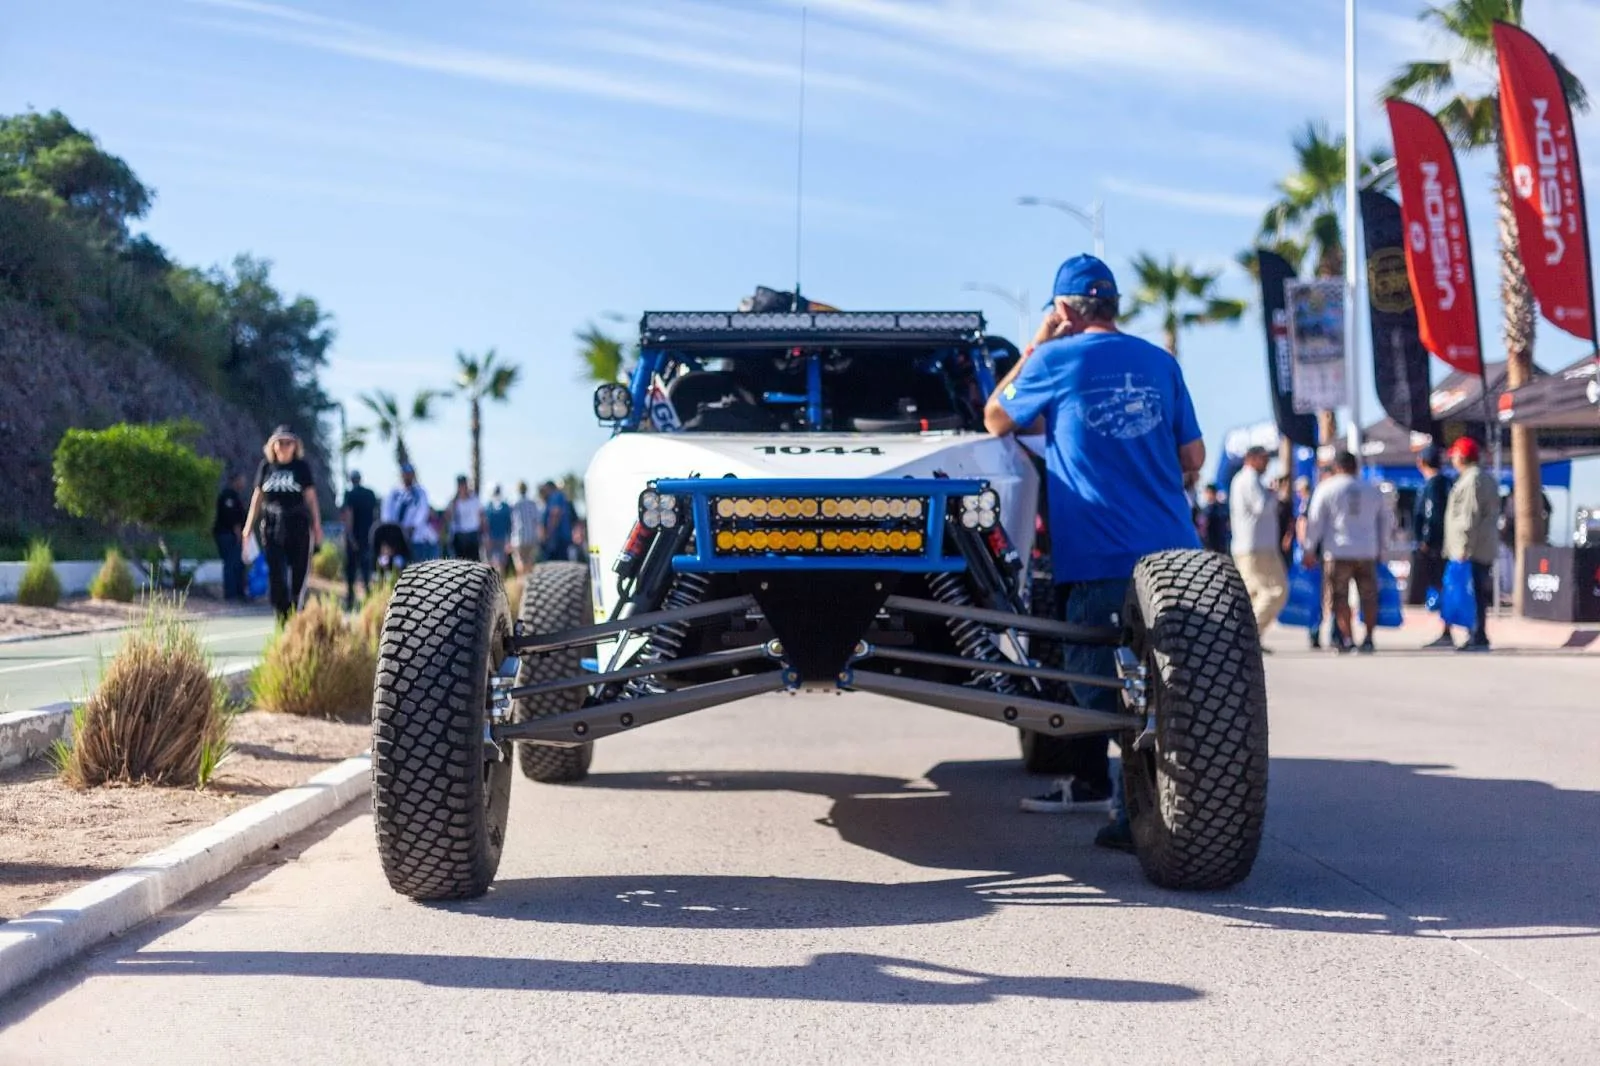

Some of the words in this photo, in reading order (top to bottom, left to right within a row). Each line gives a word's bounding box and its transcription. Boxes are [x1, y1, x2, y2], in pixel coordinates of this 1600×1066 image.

[1420, 162, 1456, 310] VISION
[1532, 98, 1565, 265] VISION
[753, 446, 885, 455] 1044
